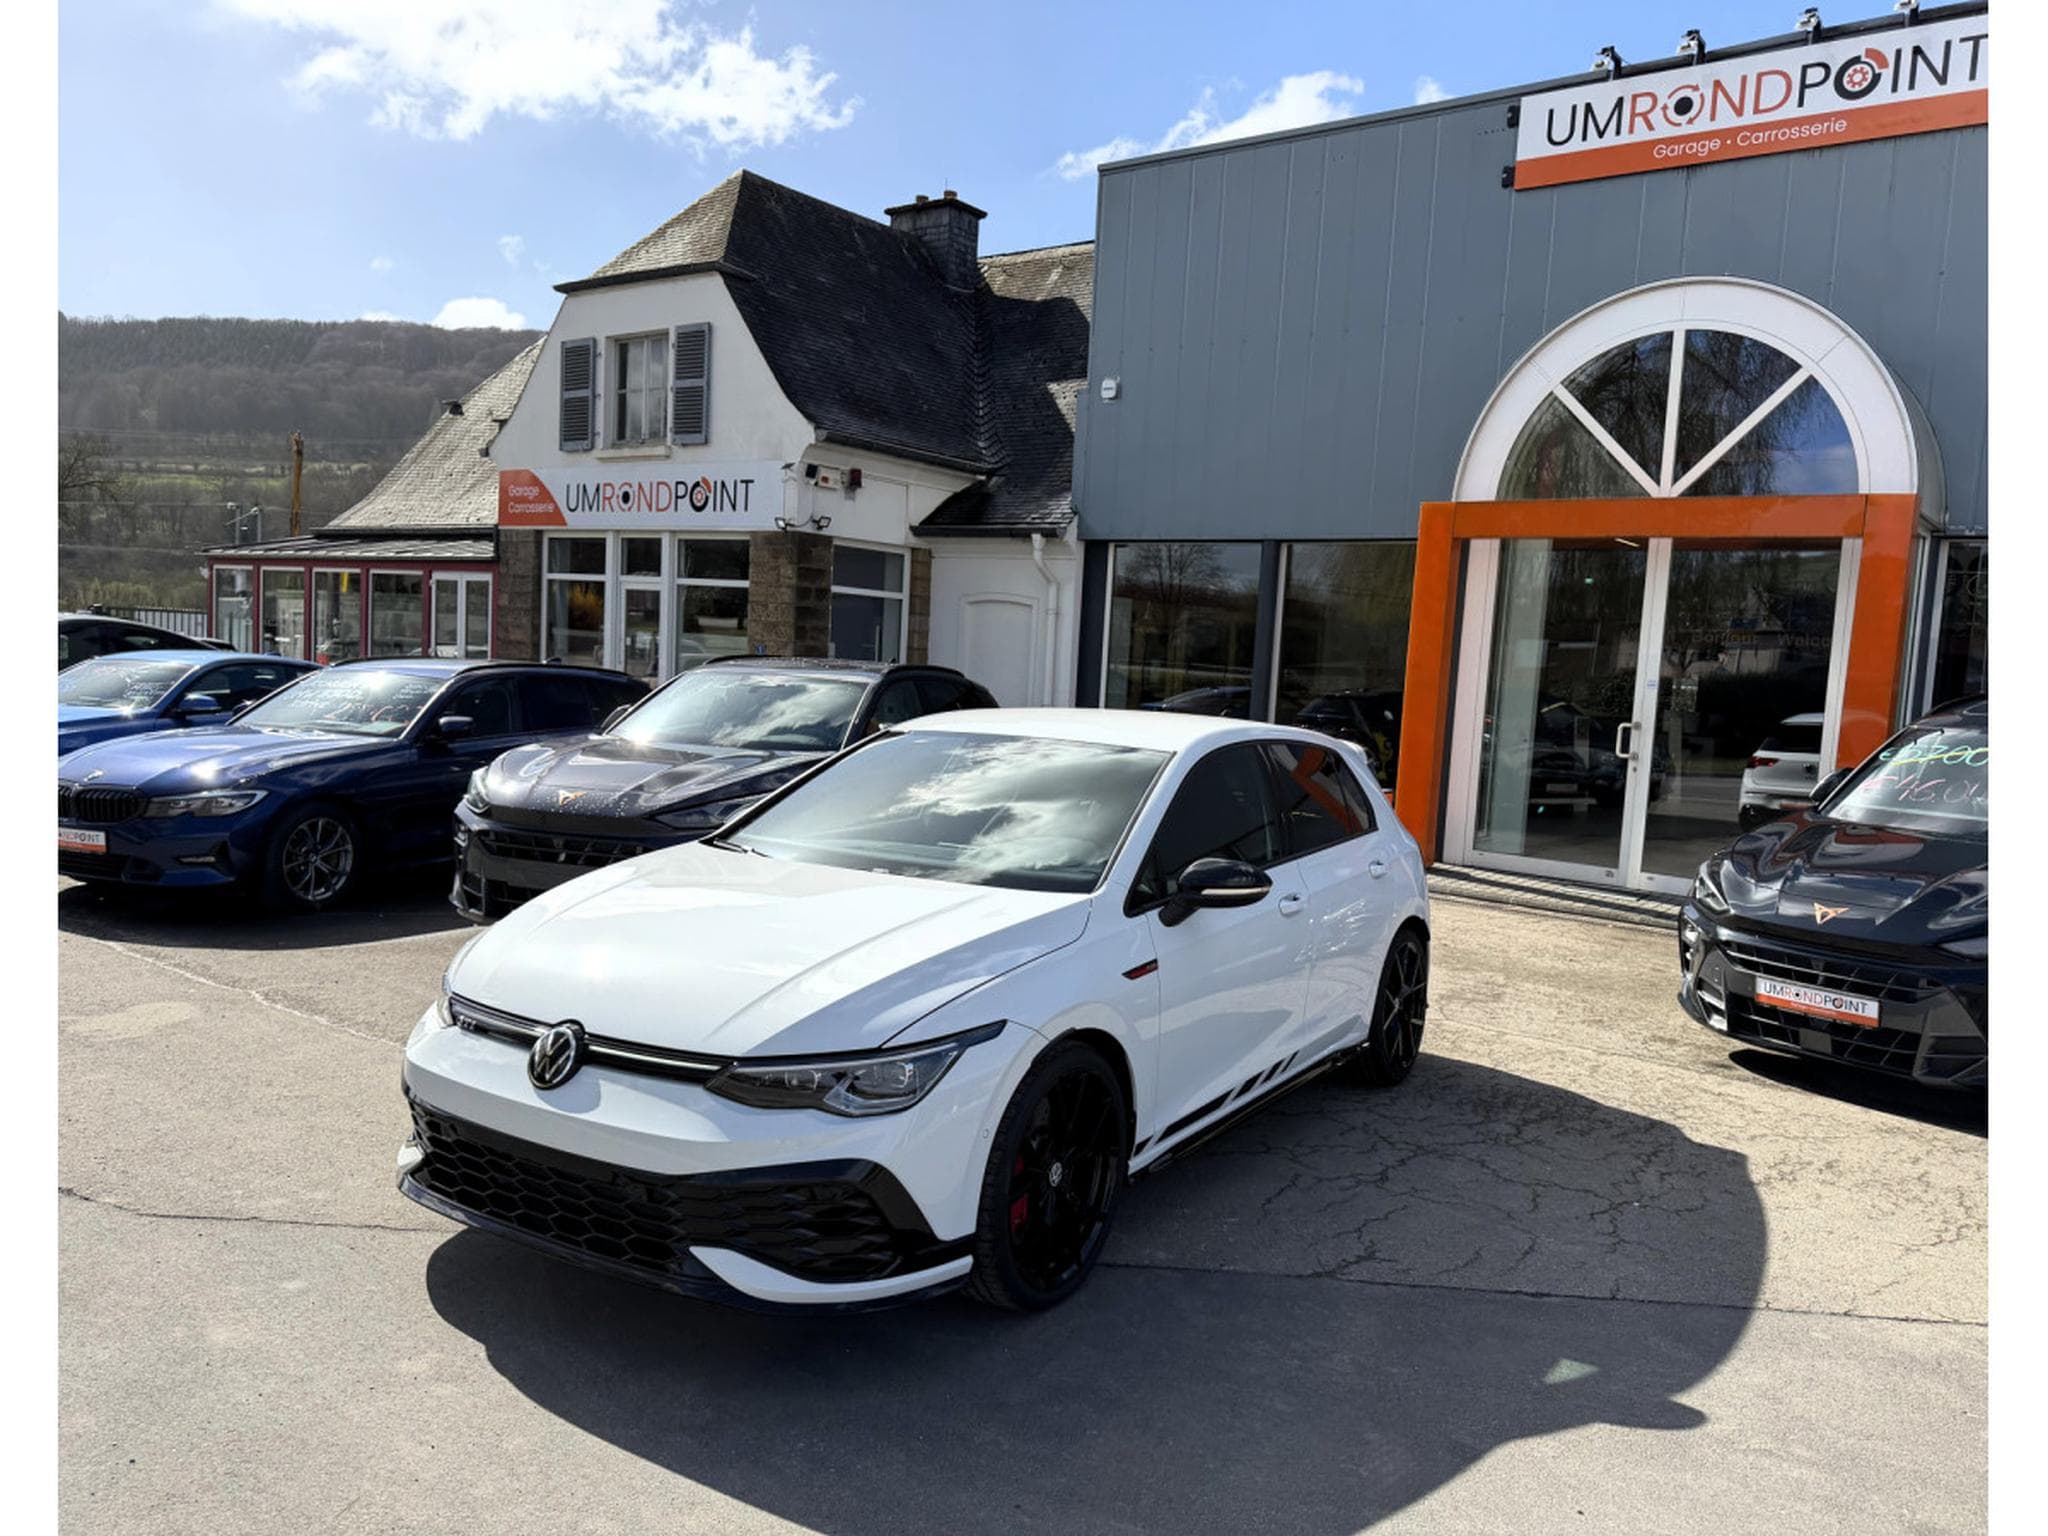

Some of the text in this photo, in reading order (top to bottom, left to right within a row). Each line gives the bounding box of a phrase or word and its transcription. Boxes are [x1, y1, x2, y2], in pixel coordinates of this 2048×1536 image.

[1546, 33, 1988, 146] UMRONDPOINT
[1653, 118, 1847, 159] Garage Carrosserie
[508, 484, 540, 499] Garage
[508, 502, 555, 513] Carrosserie
[565, 476, 755, 513] UMRONDPOINT
